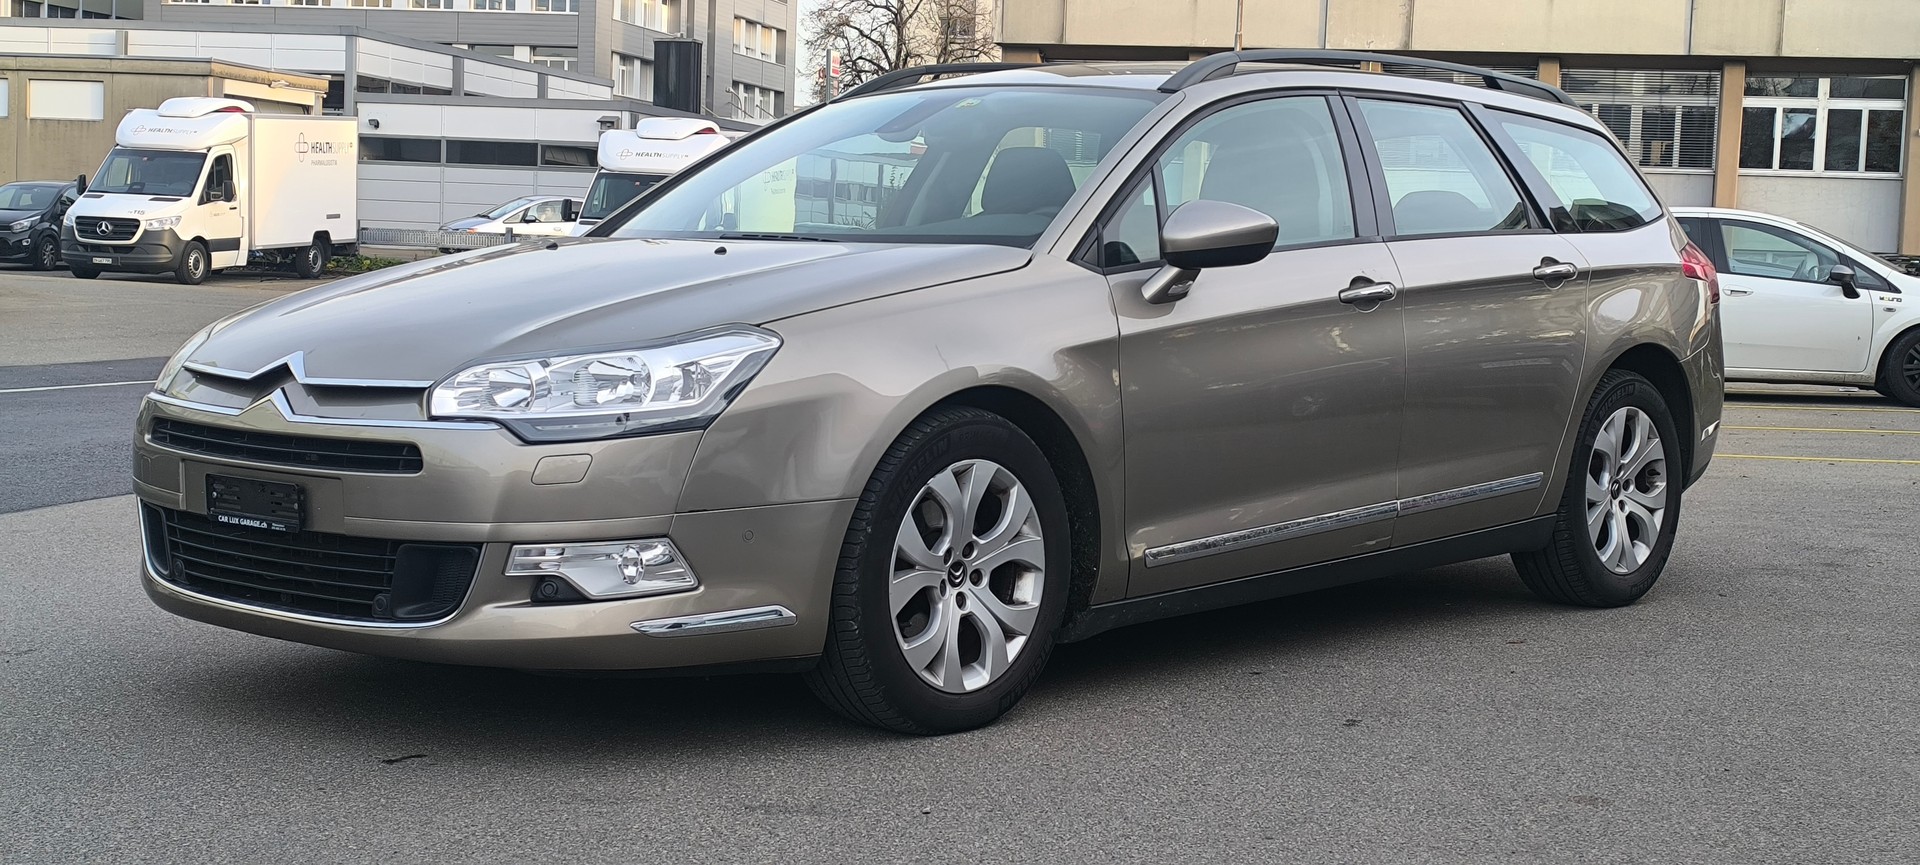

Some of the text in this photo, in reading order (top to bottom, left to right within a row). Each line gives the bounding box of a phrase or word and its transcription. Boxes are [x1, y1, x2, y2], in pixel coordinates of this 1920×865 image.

[148, 127, 193, 136] HEALTHSUPPLY
[310, 141, 349, 154] HEALTHSUPPLY
[635, 151, 684, 160] HEALTHSUPPLY
[217, 514, 229, 523] CAR
[228, 516, 240, 525] LUX
[239, 518, 268, 529] GARAGE.ch
